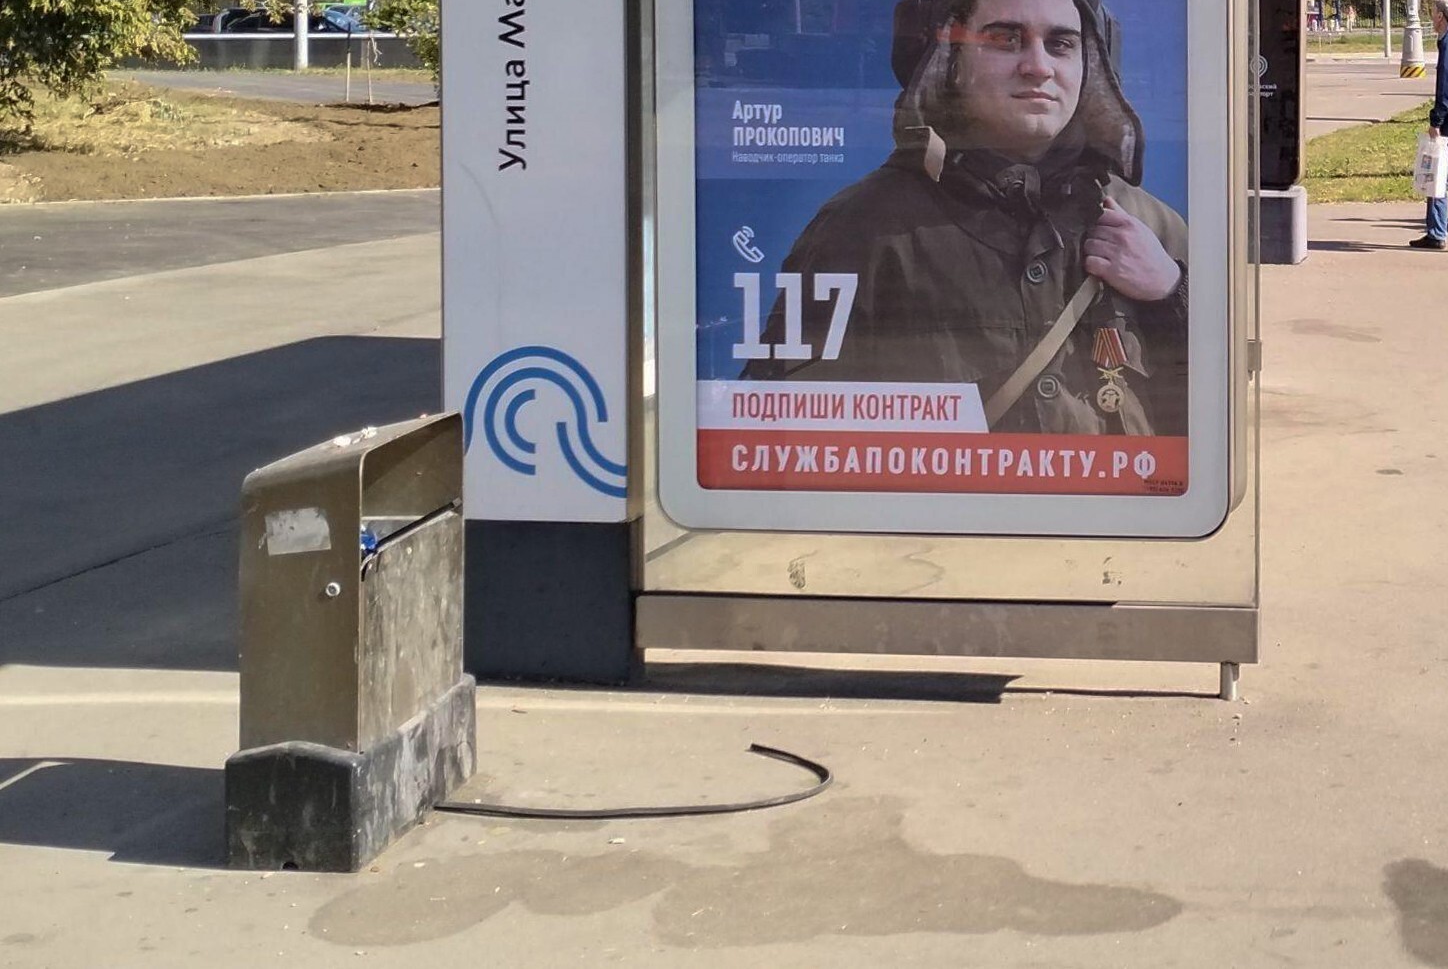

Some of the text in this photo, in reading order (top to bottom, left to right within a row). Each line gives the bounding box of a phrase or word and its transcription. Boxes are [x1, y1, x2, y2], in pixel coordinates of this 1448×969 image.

[498, 59, 530, 172] Улица
[732, 99, 783, 124] Артур
[733, 126, 845, 147] ПРОКОПОВИЧ
[732, 272, 859, 360] 117
[732, 392, 962, 422] ПОДПИШИ КОНТРАКТ
[731, 443, 1157, 480] СЛУЖБАПОКОНТРАКТУ.РФ
